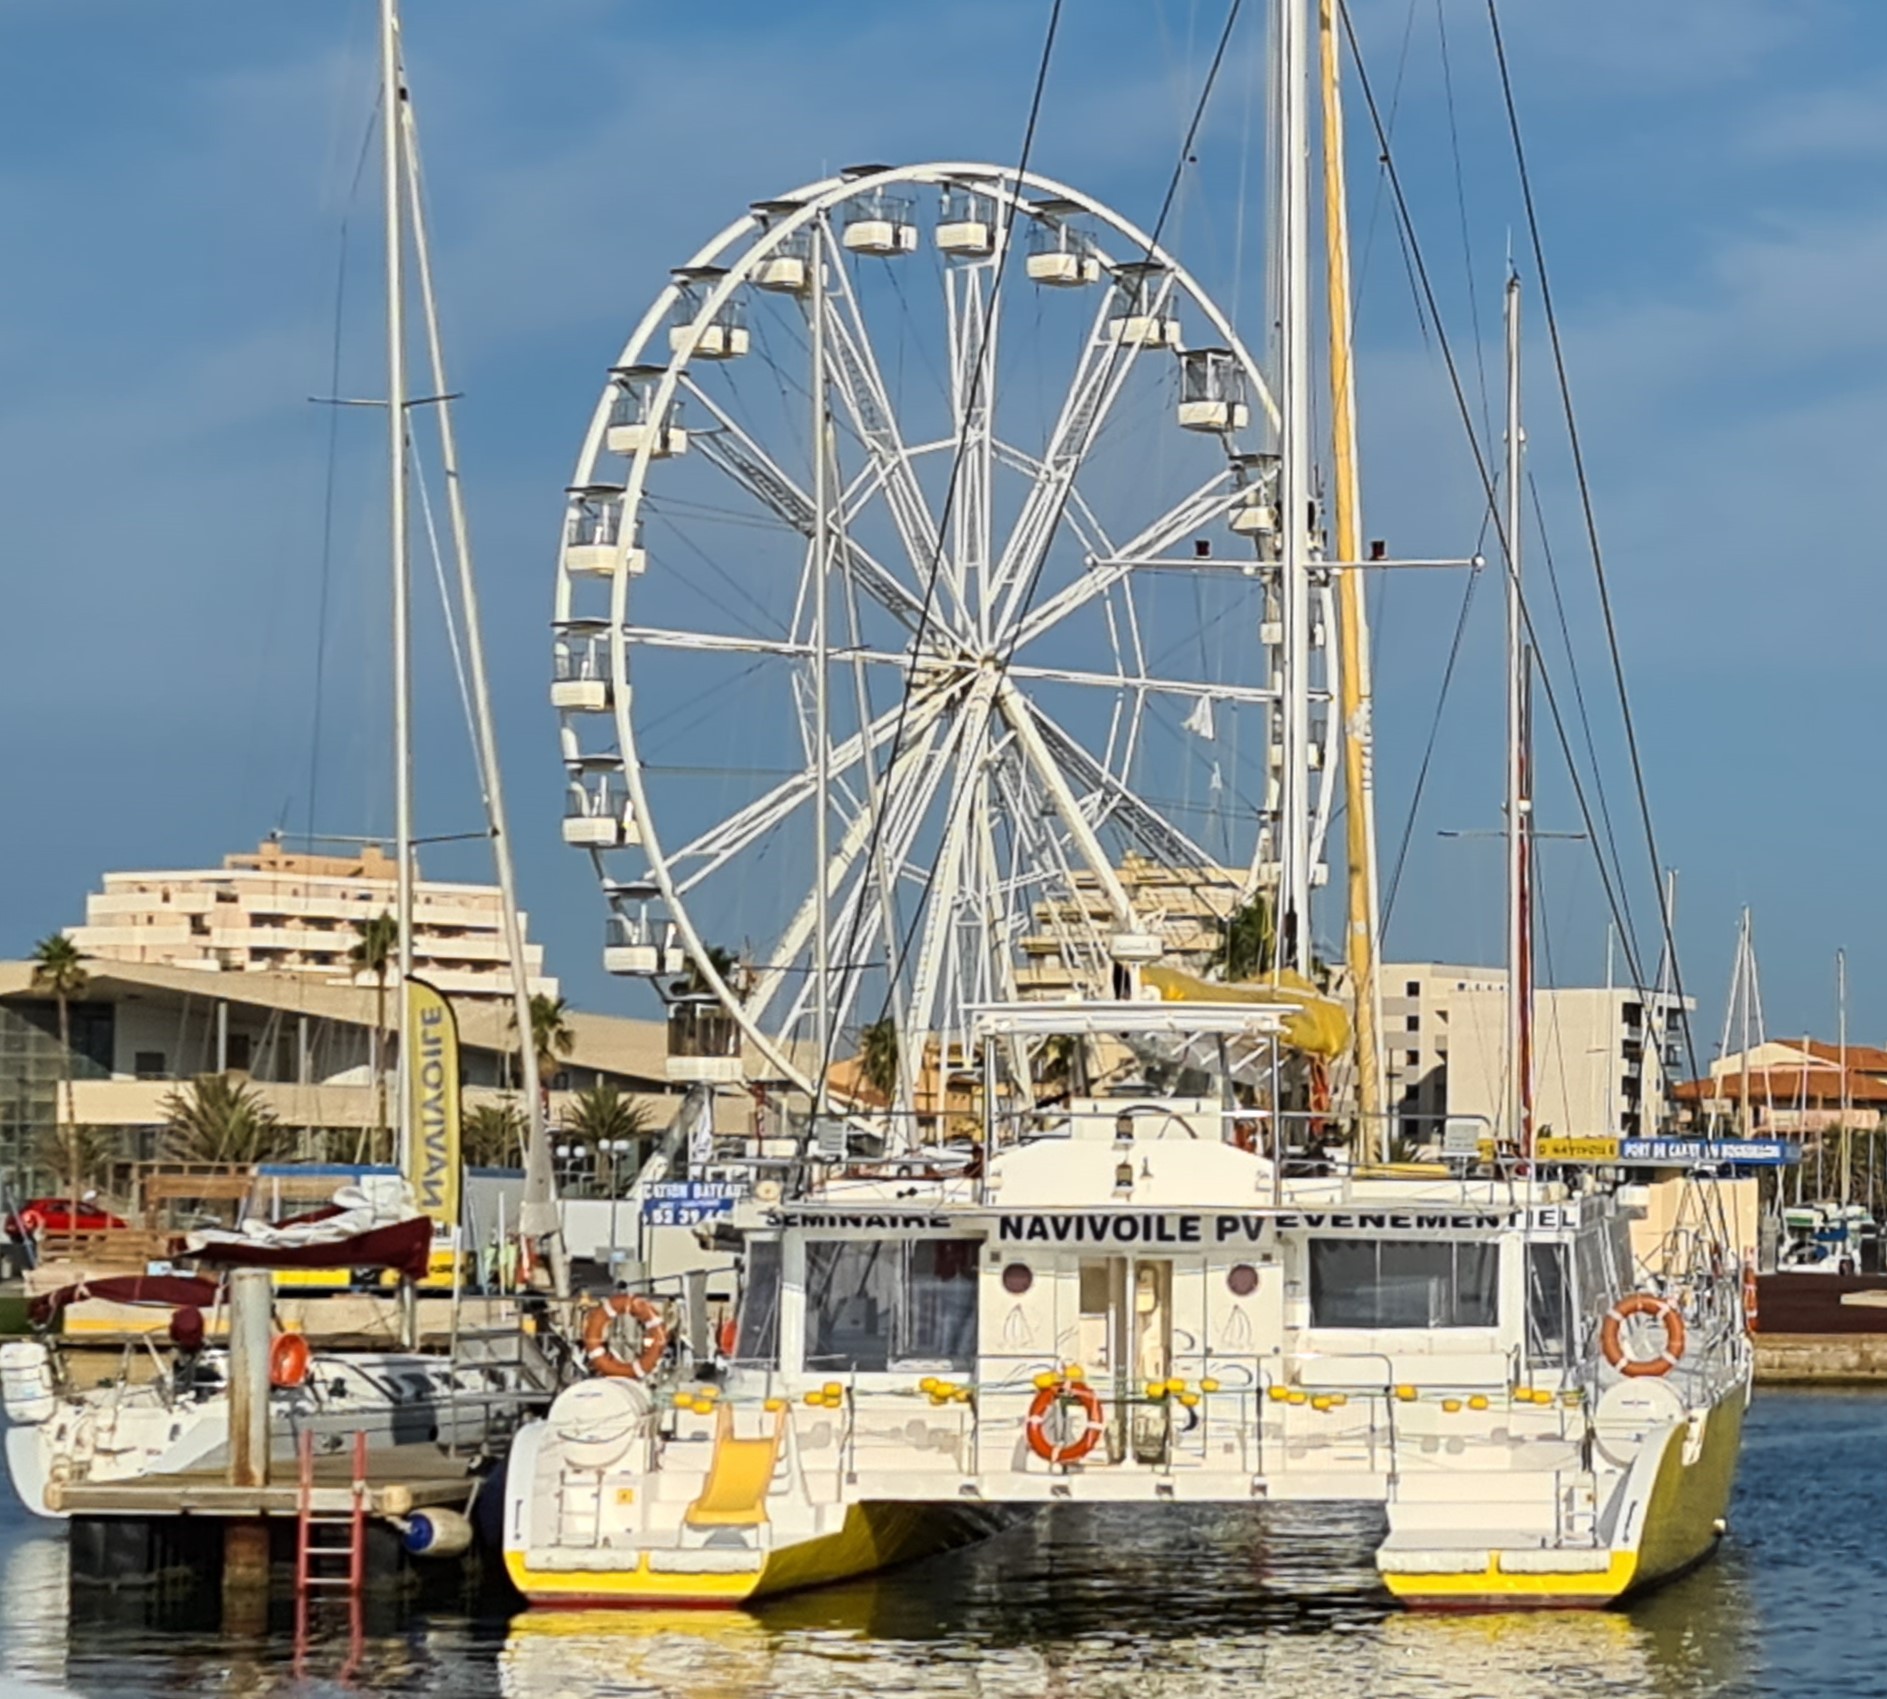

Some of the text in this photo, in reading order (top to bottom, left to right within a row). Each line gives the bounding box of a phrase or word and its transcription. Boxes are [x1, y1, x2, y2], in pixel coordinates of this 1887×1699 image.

[1000, 1214, 1266, 1242] NAVIVOILE PV
[1275, 1209, 1577, 1228] EVENEMENTIEL
